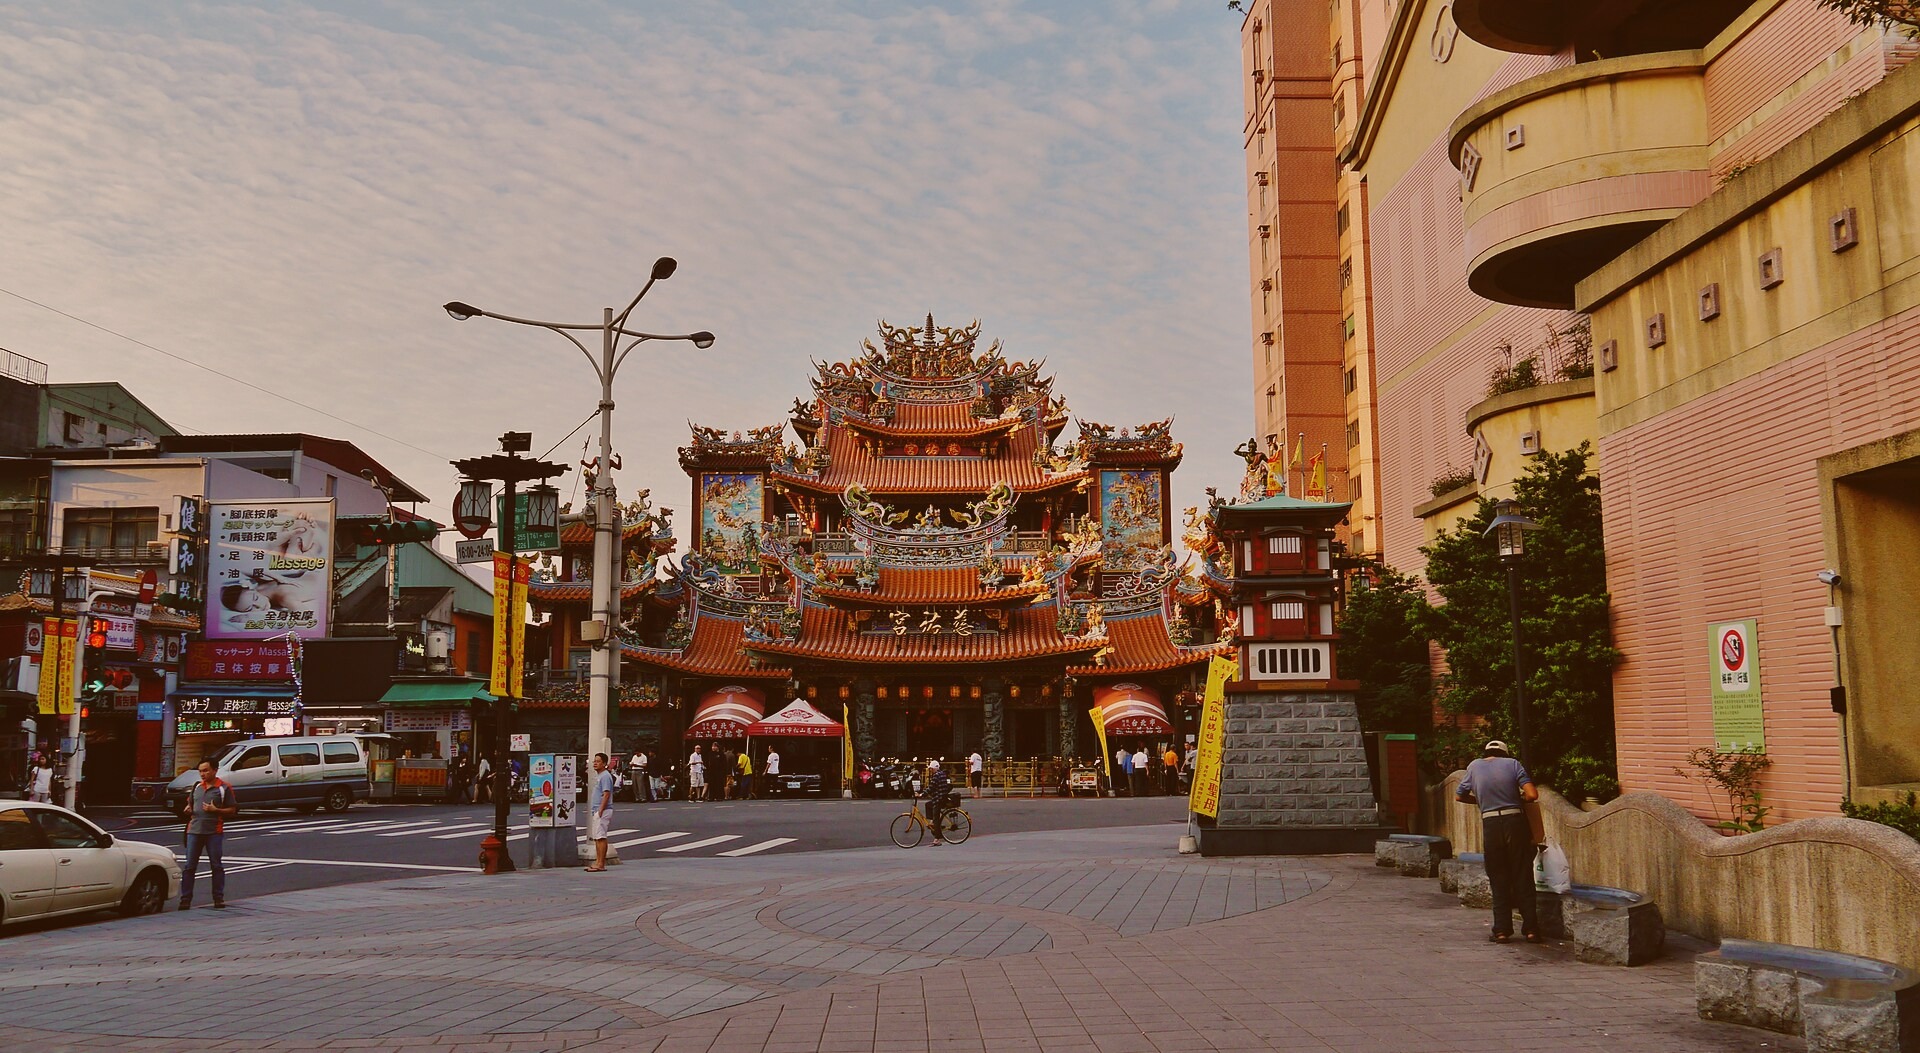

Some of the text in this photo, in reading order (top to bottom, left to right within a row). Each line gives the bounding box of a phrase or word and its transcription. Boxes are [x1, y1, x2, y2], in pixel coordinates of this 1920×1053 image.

[269, 555, 325, 570] Massage
[265, 611, 314, 621] 全身按摩
[93, 620, 106, 632] 31
[215, 647, 291, 657] マッサージ Massa
